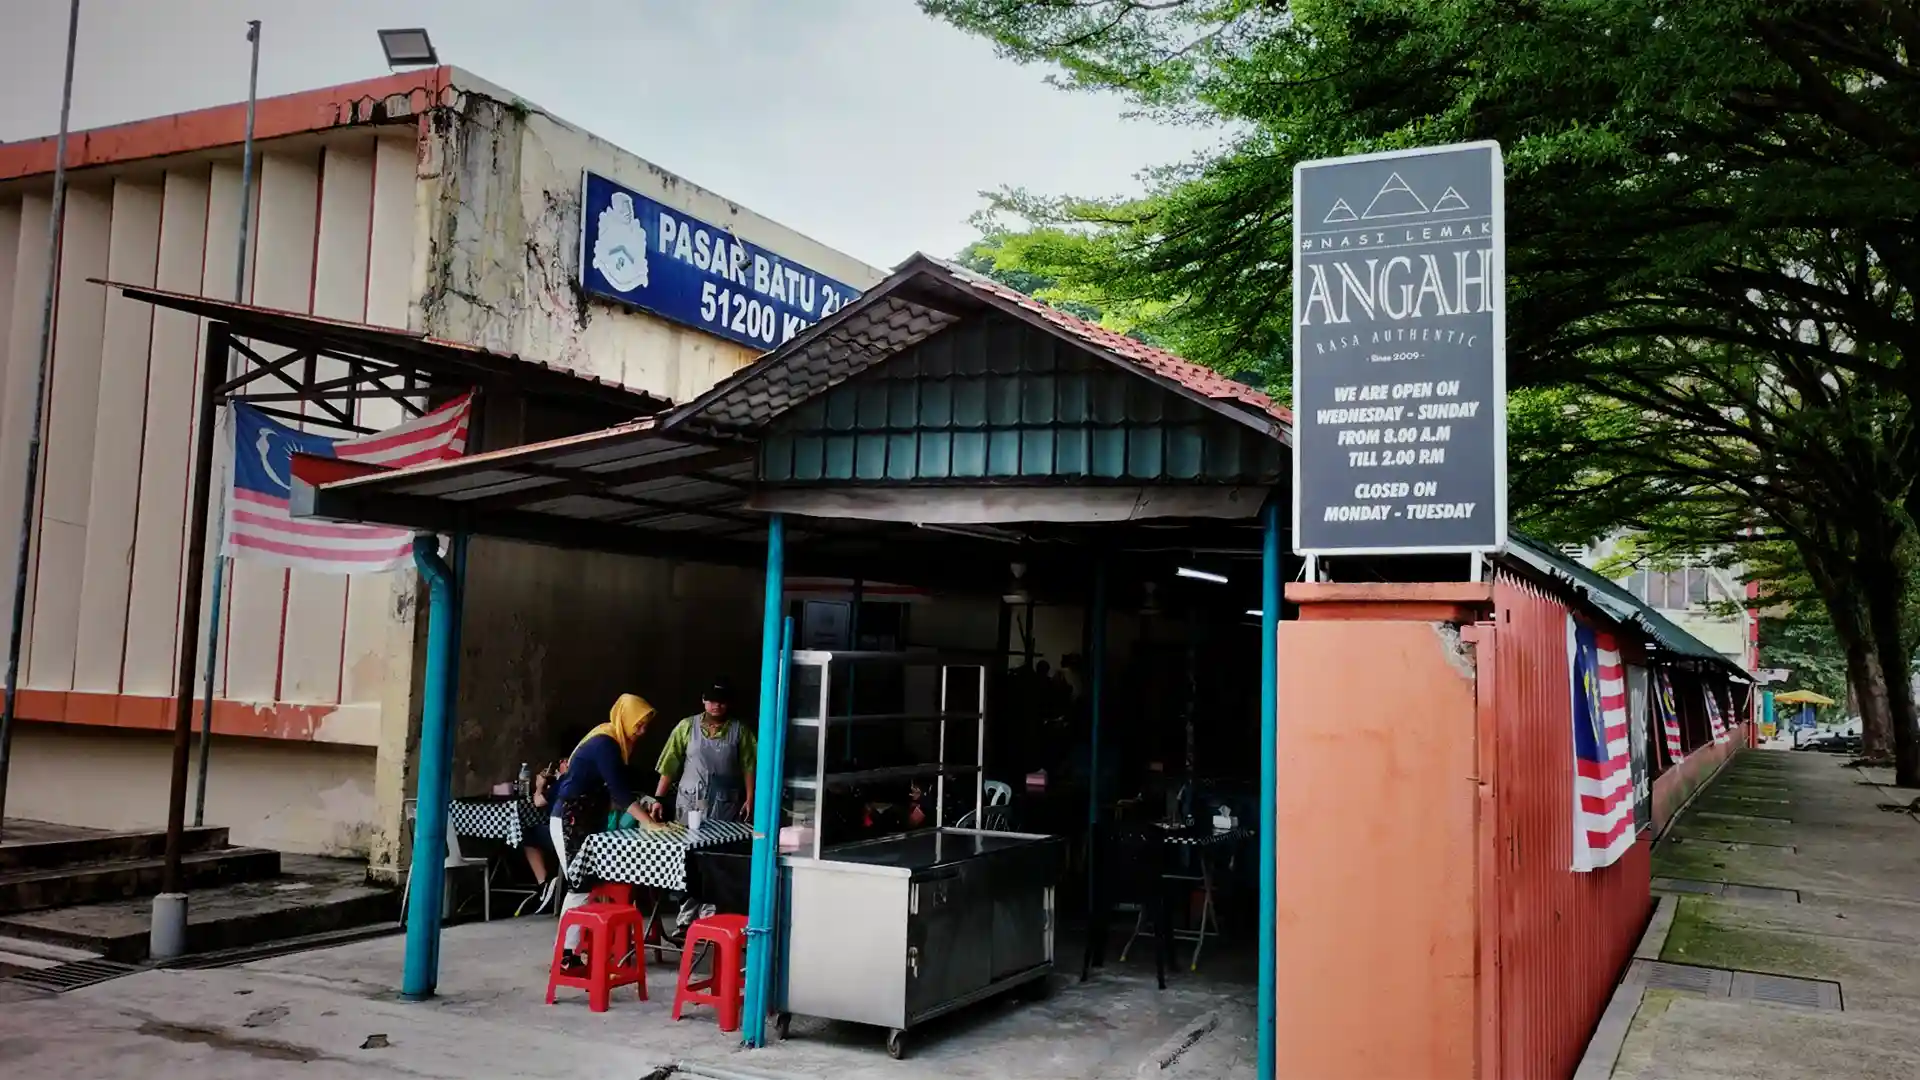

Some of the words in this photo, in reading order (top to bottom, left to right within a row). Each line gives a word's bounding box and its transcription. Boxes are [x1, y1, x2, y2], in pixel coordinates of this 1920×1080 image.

[1406, 222, 1492, 242] LEMAK
[658, 212, 748, 287] PASAR
[753, 254, 816, 312] BATU
[1300, 249, 1494, 326] ANGAH
[700, 281, 776, 343] 51200
[1316, 334, 1360, 355] RASA
[1372, 328, 1477, 347] AUTHENTIC
[1392, 351, 1419, 361] 2009
[1334, 386, 1357, 403] WE
[1358, 384, 1389, 401] ARE
[1391, 381, 1433, 399] OPEN
[1436, 380, 1460, 396] ON
[1316, 405, 1404, 425] WEDNESDAY
[1417, 401, 1480, 421] SUNDAY
[1337, 428, 1380, 446] FROM
[1383, 426, 1418, 444] 8.00
[1419, 425, 1451, 442] A.M
[1348, 451, 1379, 468] TILL
[1381, 449, 1416, 467] 2.00
[1354, 482, 1410, 499] CLOSED
[1413, 480, 1438, 497] ON
[1323, 505, 1392, 523] MONDAY
[1406, 502, 1477, 520] TUESDAY
